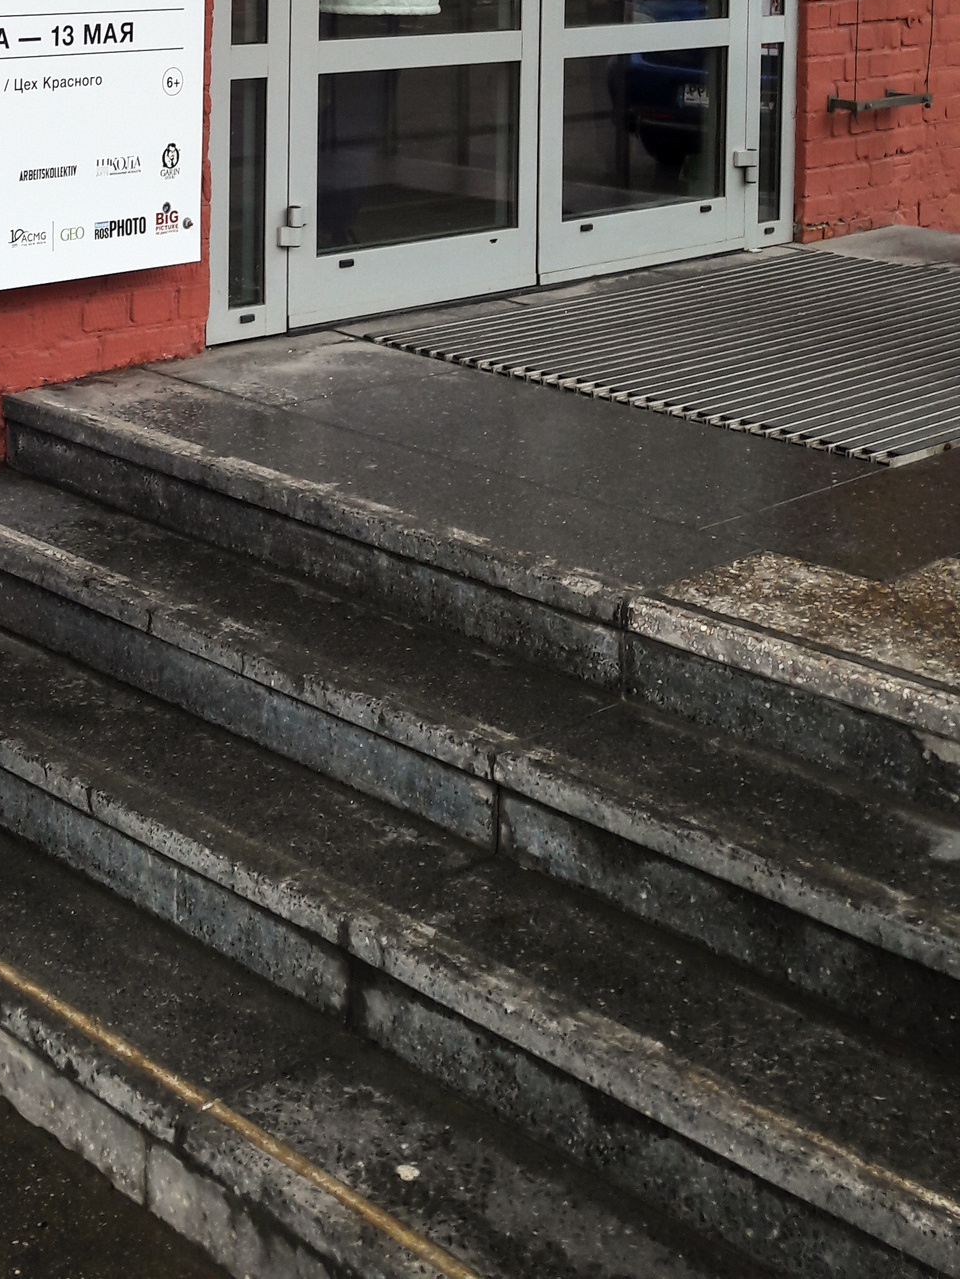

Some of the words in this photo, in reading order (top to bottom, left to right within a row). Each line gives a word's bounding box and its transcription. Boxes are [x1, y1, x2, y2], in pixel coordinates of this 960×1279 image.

[51, 24, 75, 47] 13
[83, 22, 134, 45] МАЯ
[14, 78, 38, 93] Цех
[42, 73, 103, 92] Красного
[166, 75, 181, 90] 6+
[19, 165, 77, 181] ARBEITSKOLLEKTIV
[60, 226, 85, 241] GEO
